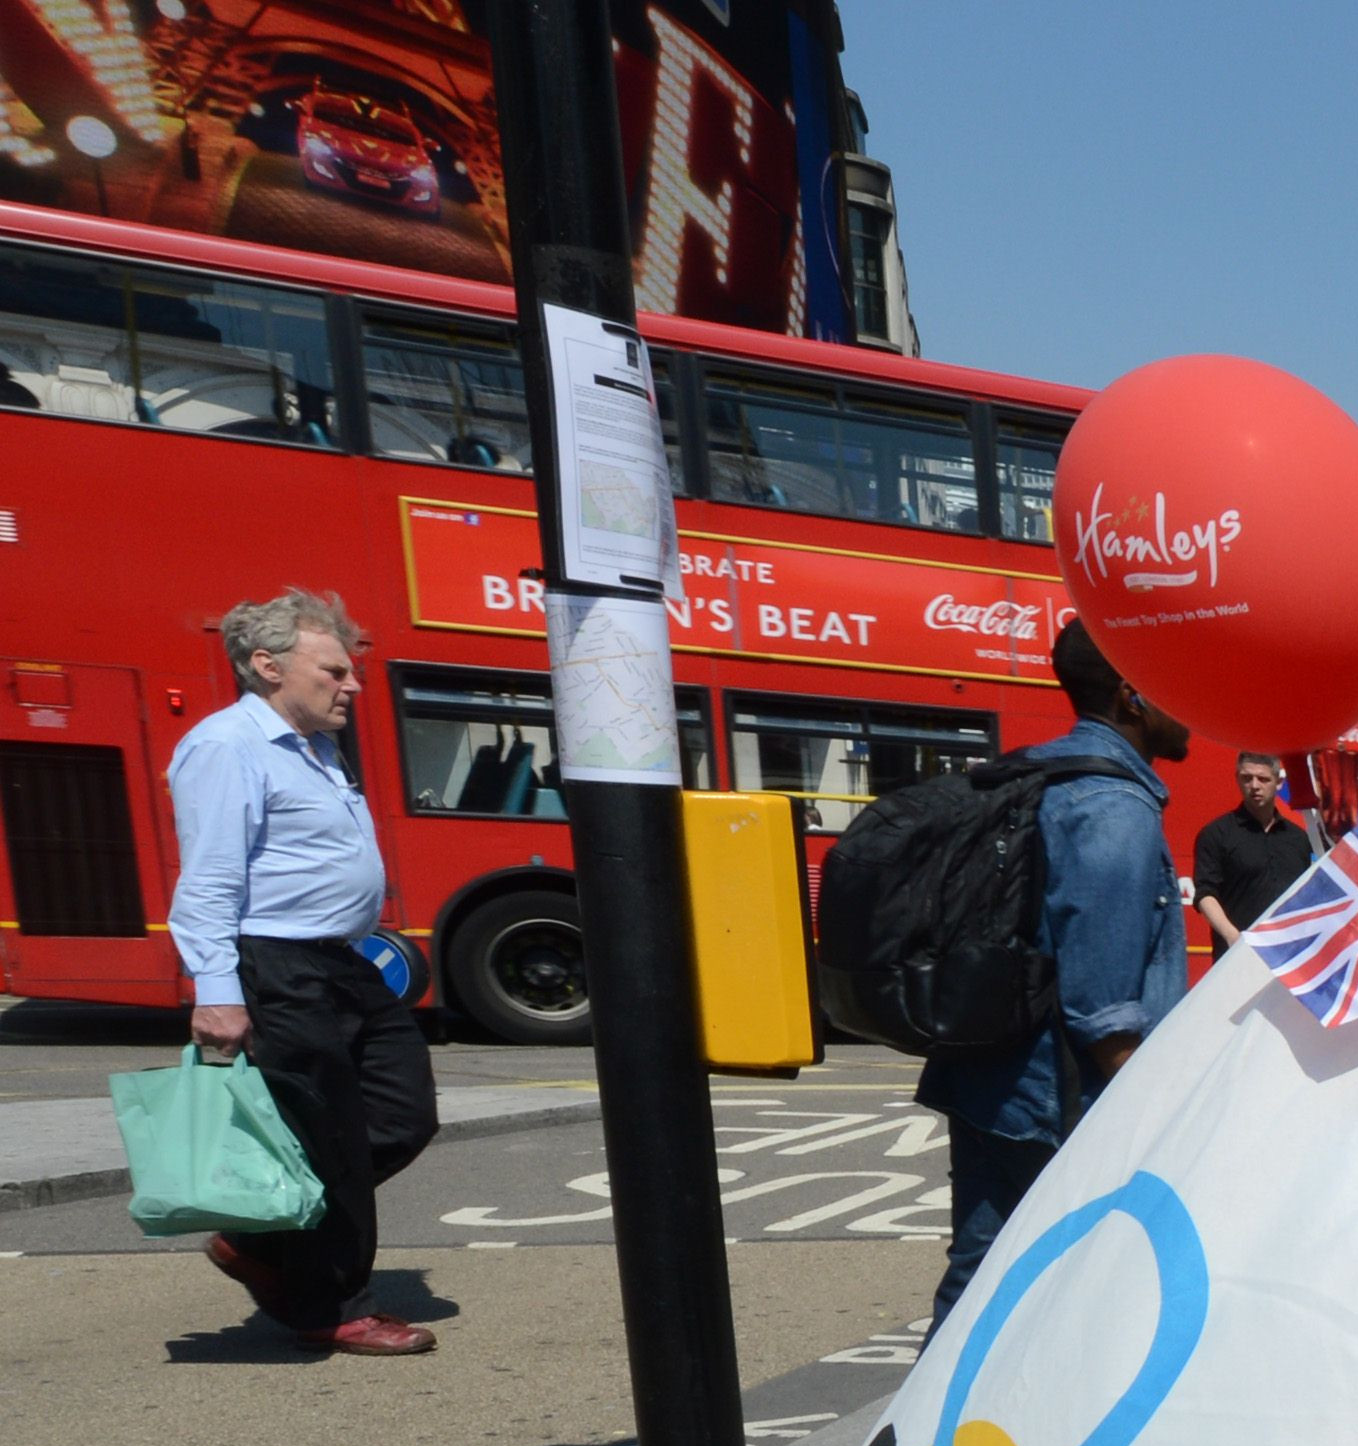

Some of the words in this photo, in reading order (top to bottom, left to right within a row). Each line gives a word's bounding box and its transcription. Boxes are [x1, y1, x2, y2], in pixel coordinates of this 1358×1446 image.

[1074, 482, 1242, 588] Hamleys
[678, 553, 775, 584] BRATE
[758, 604, 877, 646] BEAT
[1159, 612, 1183, 625] Shop
[1197, 607, 1215, 618] the
[1216, 602, 1249, 616] World
[975, 649, 1047, 664] WORLDWIDE
